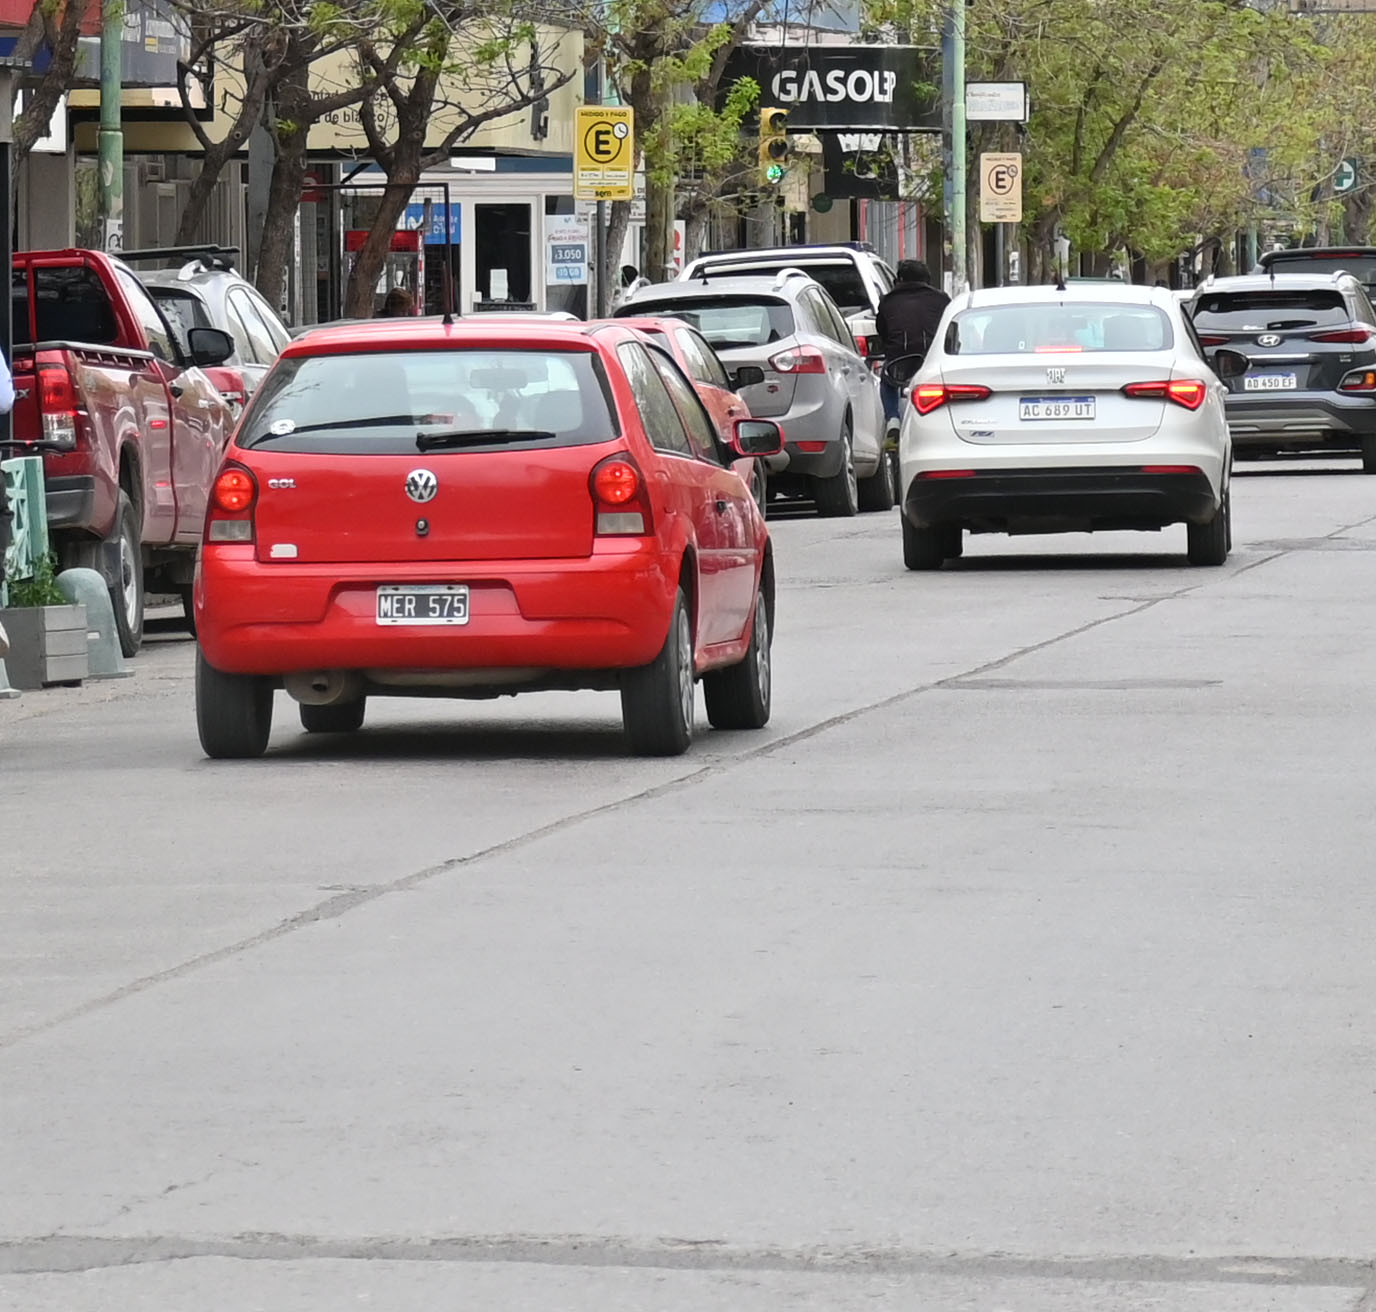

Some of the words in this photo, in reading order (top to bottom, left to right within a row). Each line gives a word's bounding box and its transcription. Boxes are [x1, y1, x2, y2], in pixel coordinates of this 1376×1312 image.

[343, 111, 385, 123] blao
[595, 130, 612, 155] E
[995, 170, 1006, 189] E
[1247, 378, 1259, 388] AD
[1262, 377, 1280, 388] 450
[1282, 377, 1293, 387] EF
[1024, 405, 1040, 416] AC
[1045, 404, 1070, 416] 689
[1075, 404, 1092, 415] UT
[380, 595, 416, 617] MER
[429, 595, 465, 617] 575
